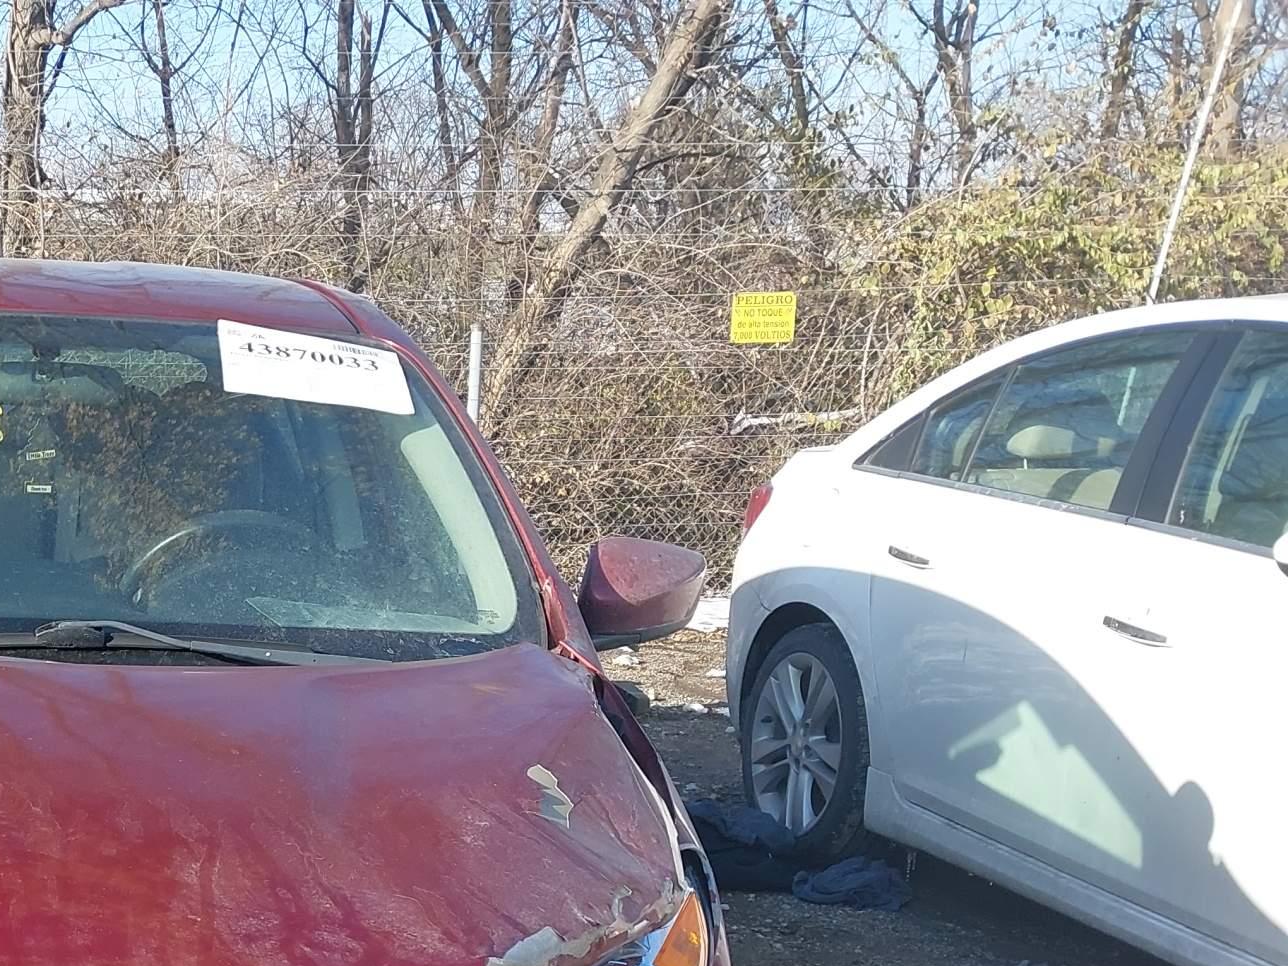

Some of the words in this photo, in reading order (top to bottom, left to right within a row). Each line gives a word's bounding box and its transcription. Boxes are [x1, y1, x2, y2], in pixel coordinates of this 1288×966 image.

[737, 295, 793, 305] PELIGRO
[743, 308, 755, 318] NO
[757, 307, 784, 317] TOQUE
[755, 330, 791, 340] VOLTIOS
[239, 341, 379, 372] 43870033
